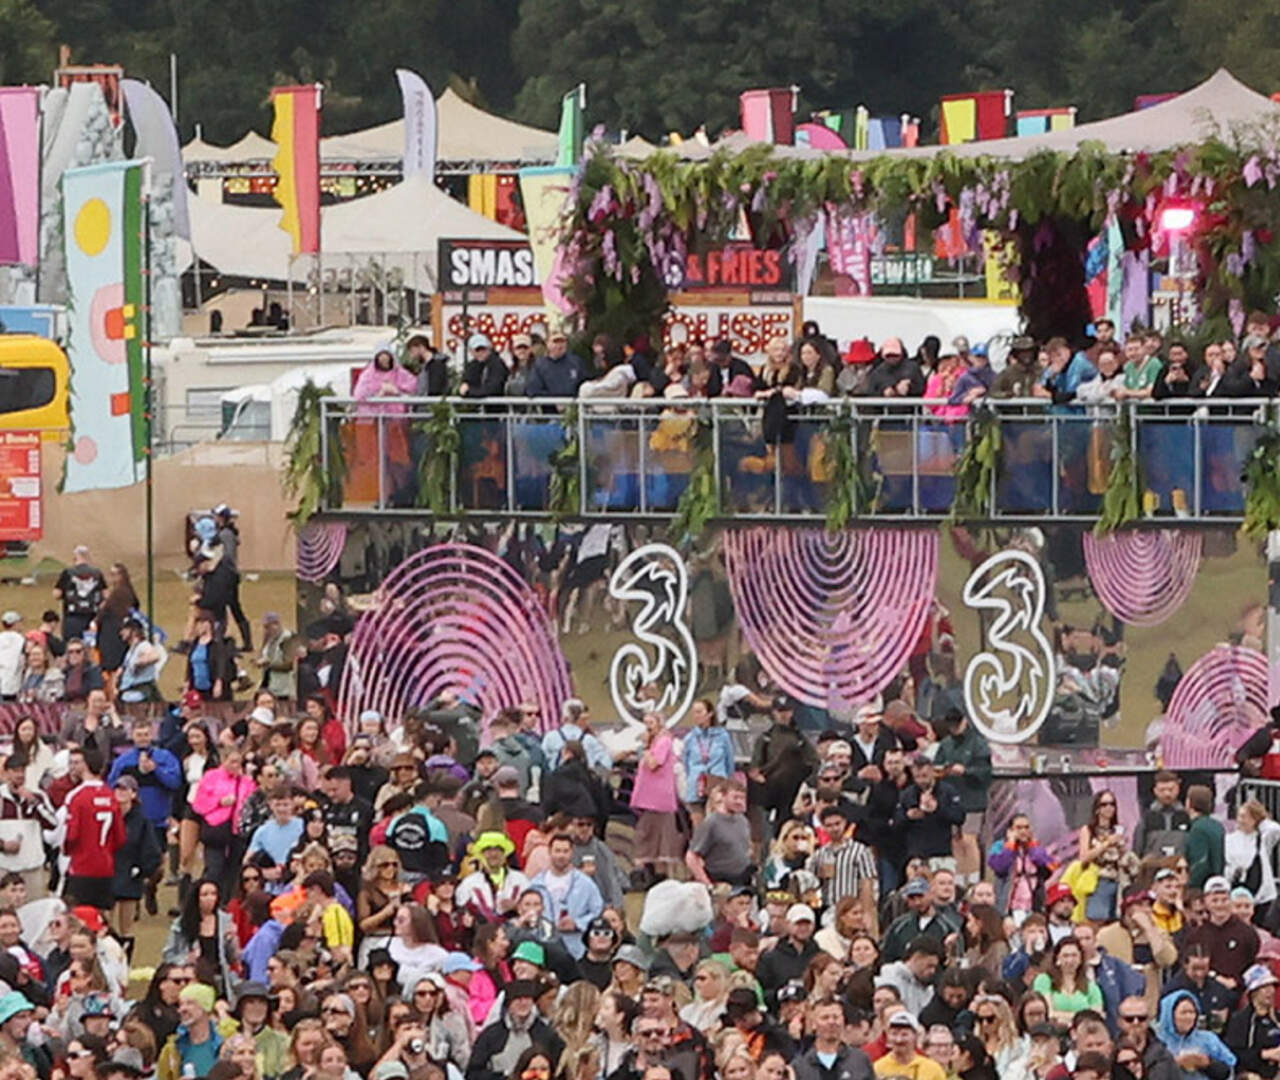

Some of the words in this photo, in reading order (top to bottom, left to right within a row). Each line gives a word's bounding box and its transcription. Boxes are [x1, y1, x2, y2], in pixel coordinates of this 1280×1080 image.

[451, 249, 539, 285] SMAS
[707, 250, 783, 285] FRIES
[96, 812, 114, 846] 7
